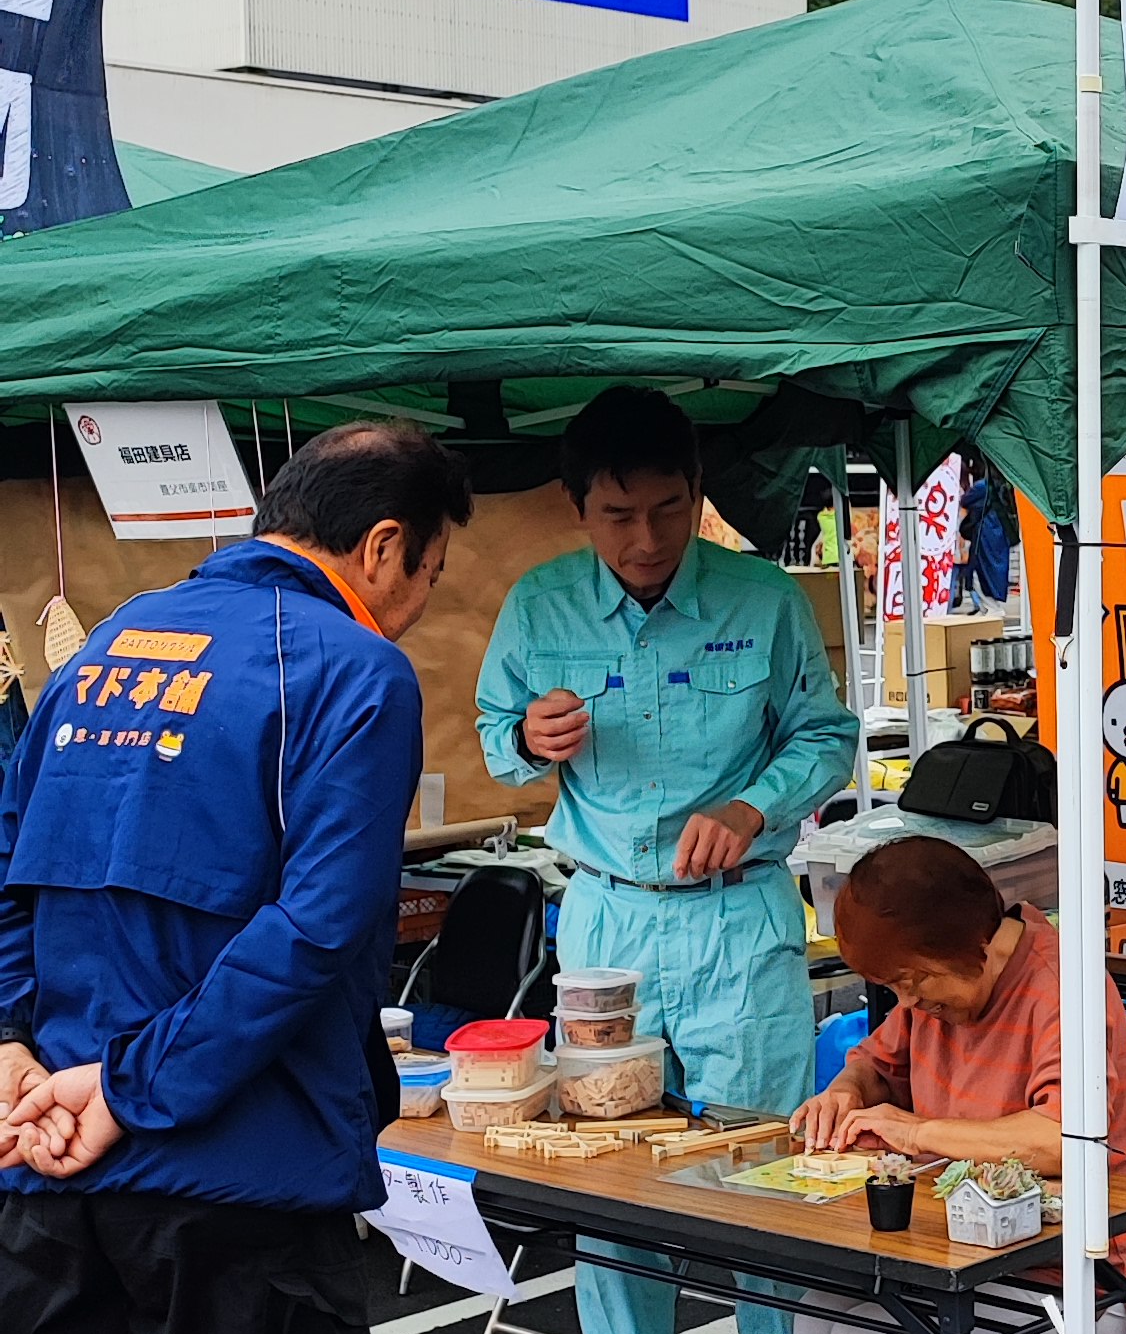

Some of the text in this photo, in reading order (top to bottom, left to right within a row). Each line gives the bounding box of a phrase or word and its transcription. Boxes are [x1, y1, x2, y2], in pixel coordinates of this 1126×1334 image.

[118, 443, 192, 465] 福田建具店
[77, 665, 213, 716] マド本舗
